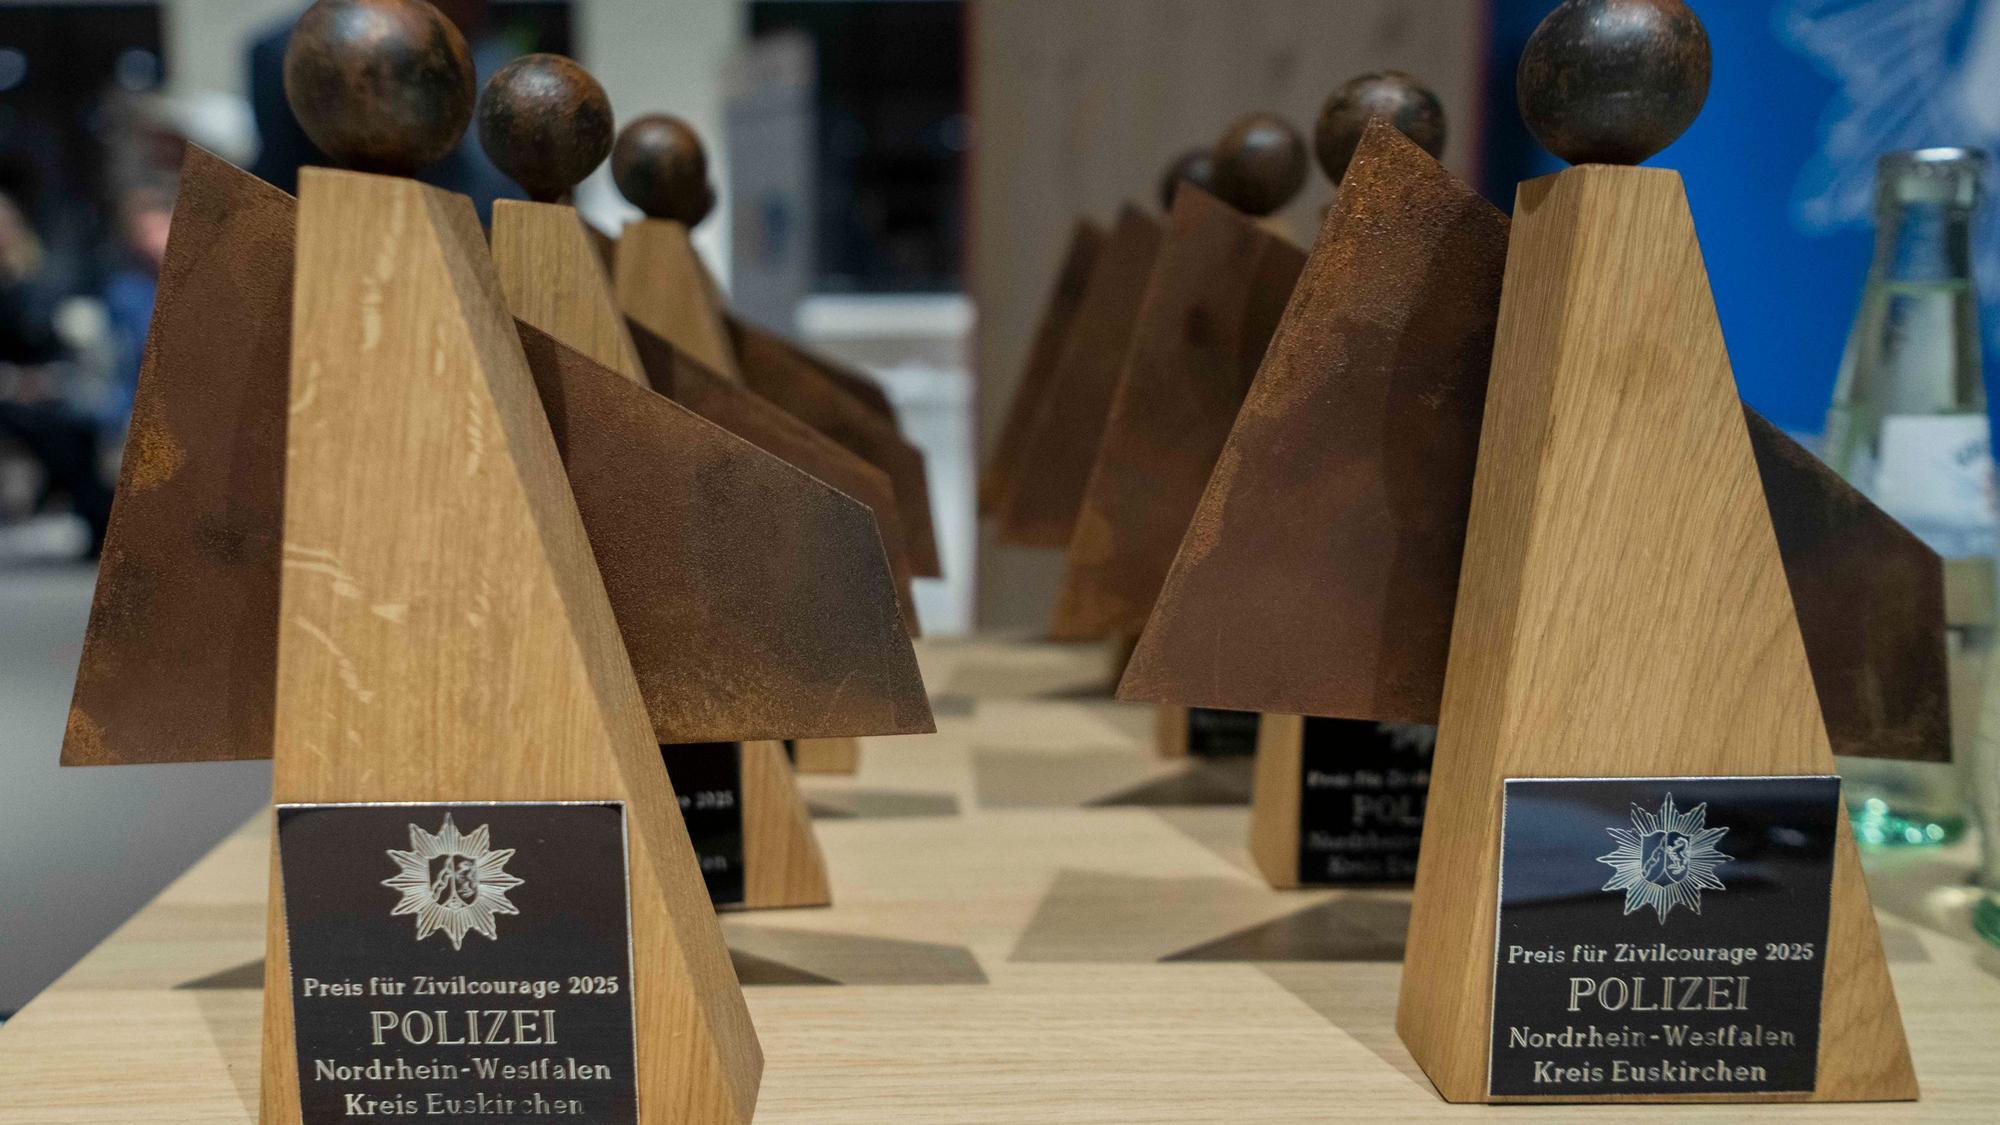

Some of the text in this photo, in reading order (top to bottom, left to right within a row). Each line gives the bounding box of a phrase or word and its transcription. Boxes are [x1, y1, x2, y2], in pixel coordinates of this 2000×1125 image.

[1508, 943, 1814, 966] Preis für Zivilcourage 2025
[303, 975, 619, 999] Preis für Zivilcourage 2025
[1567, 976, 1750, 1011] POLIZEI
[370, 1009, 557, 1045] POLIZEI
[1508, 1024, 1795, 1049] Nordrhein-Westfalen
[314, 1057, 612, 1081] Nordrhein-Westfalen
[1533, 1060, 1767, 1083] Kreis Euskirchen
[345, 1092, 584, 1116] Kreis Euskirchen
